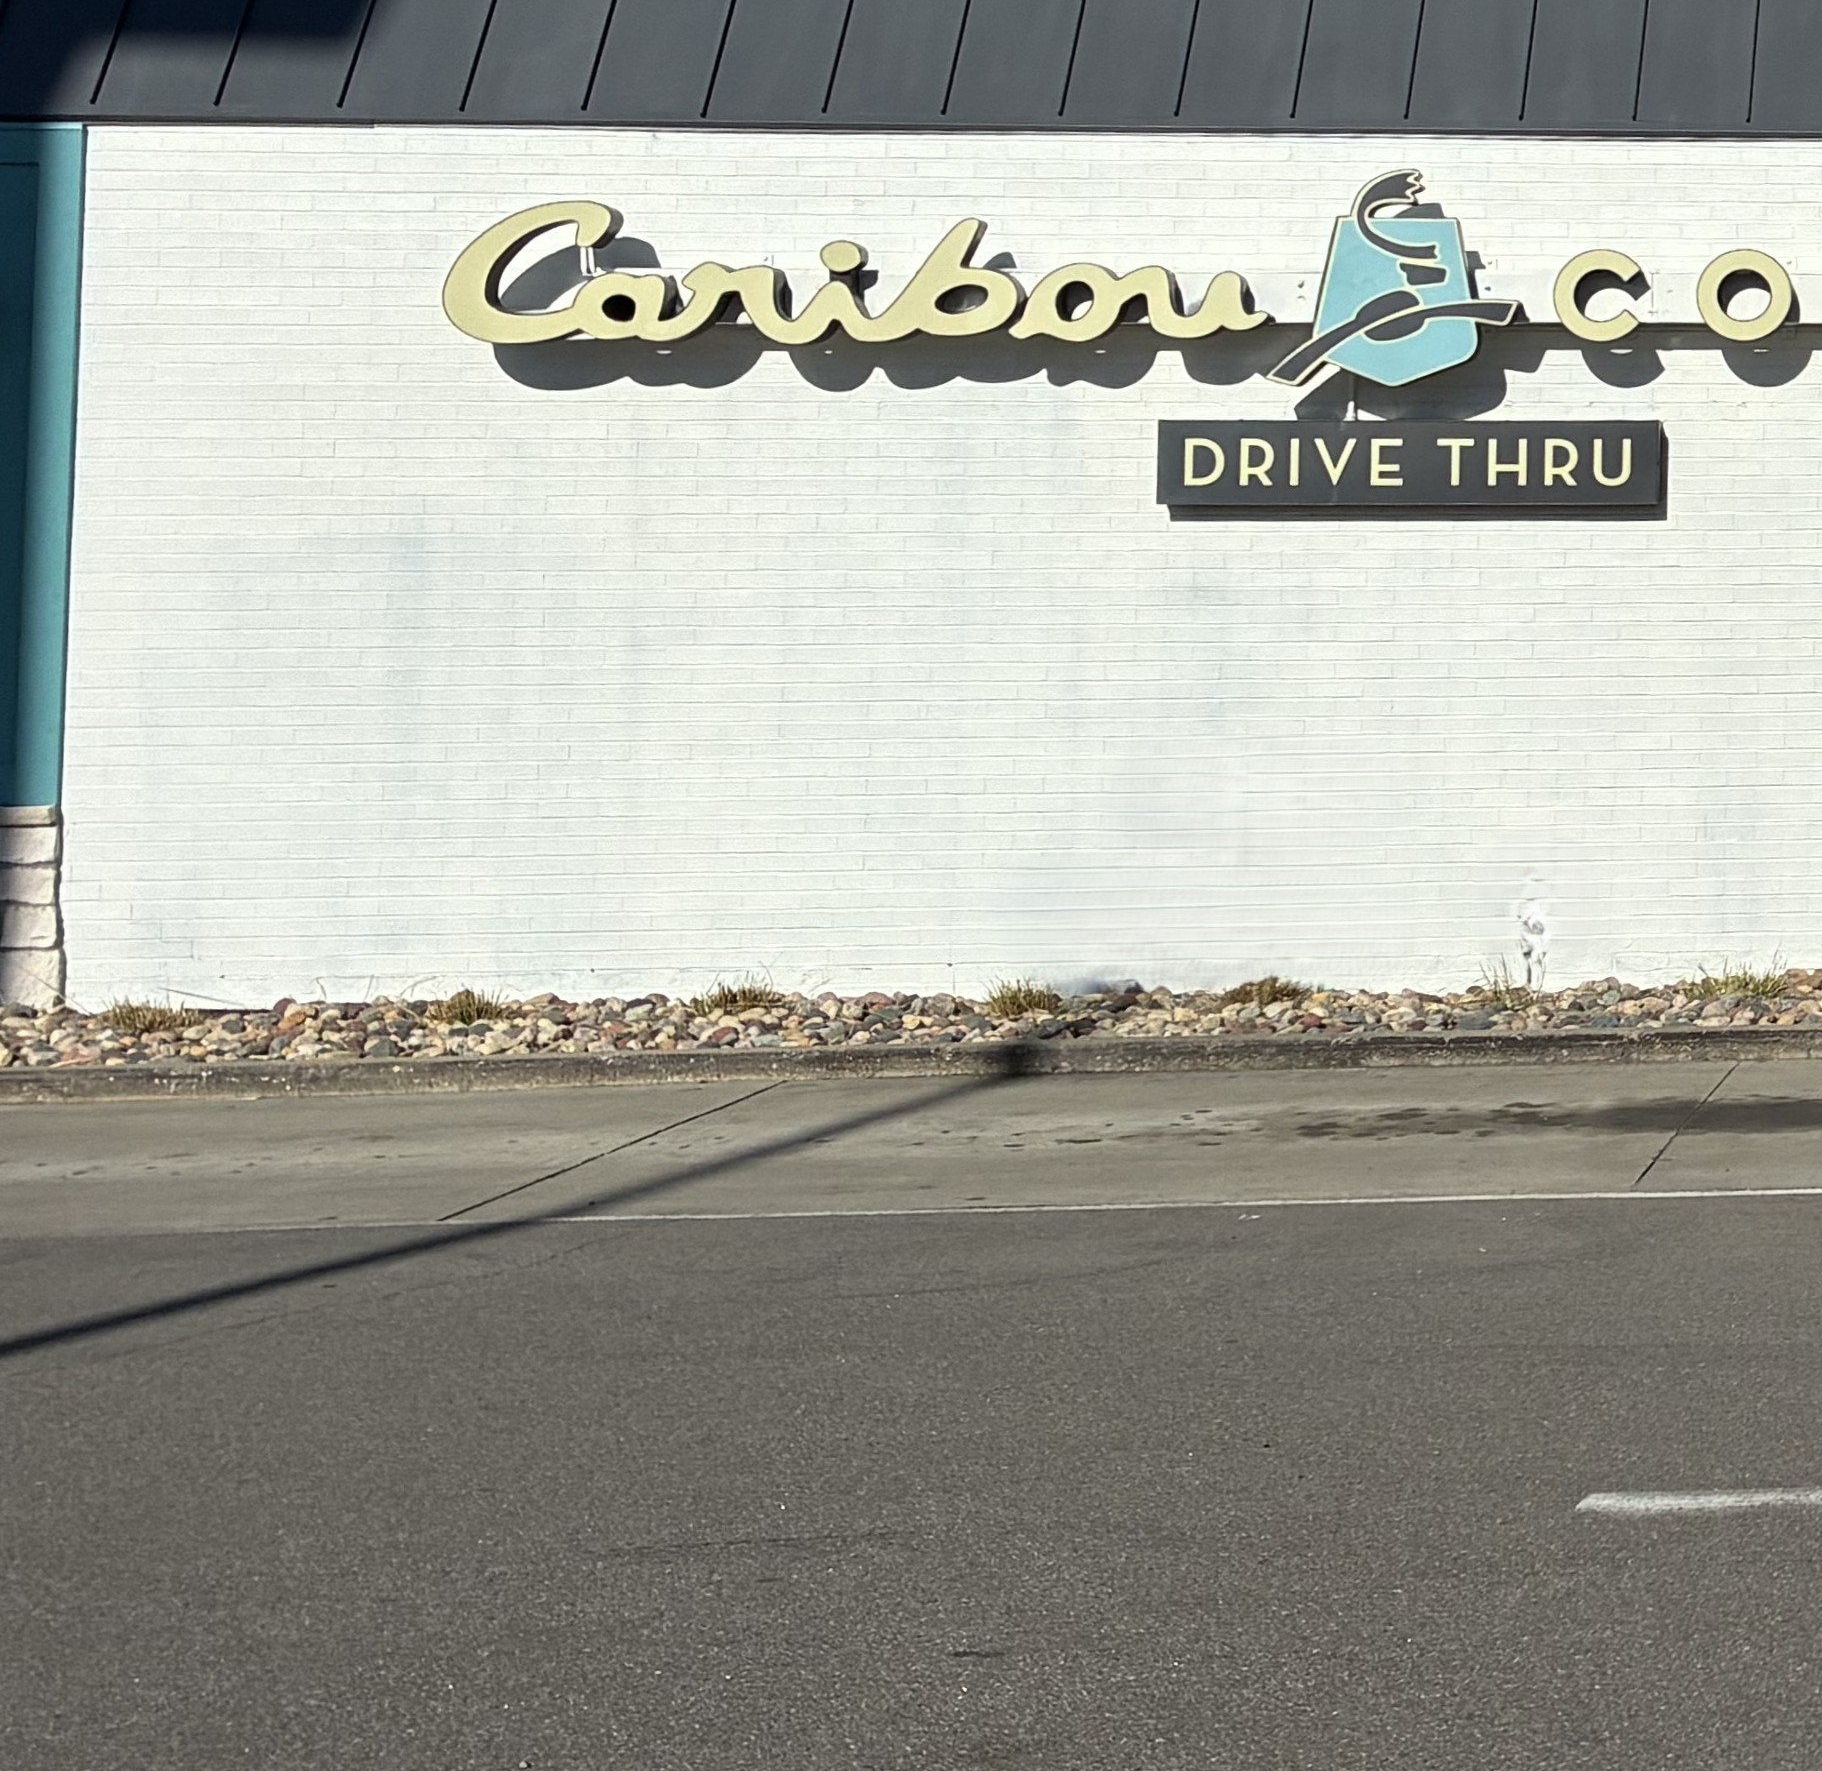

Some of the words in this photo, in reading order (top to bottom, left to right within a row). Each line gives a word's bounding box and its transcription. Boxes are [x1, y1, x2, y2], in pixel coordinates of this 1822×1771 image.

[442, 199, 1270, 345] Caribou
[1182, 437, 1406, 488] DRIVE
[1436, 437, 1635, 488] THRU
